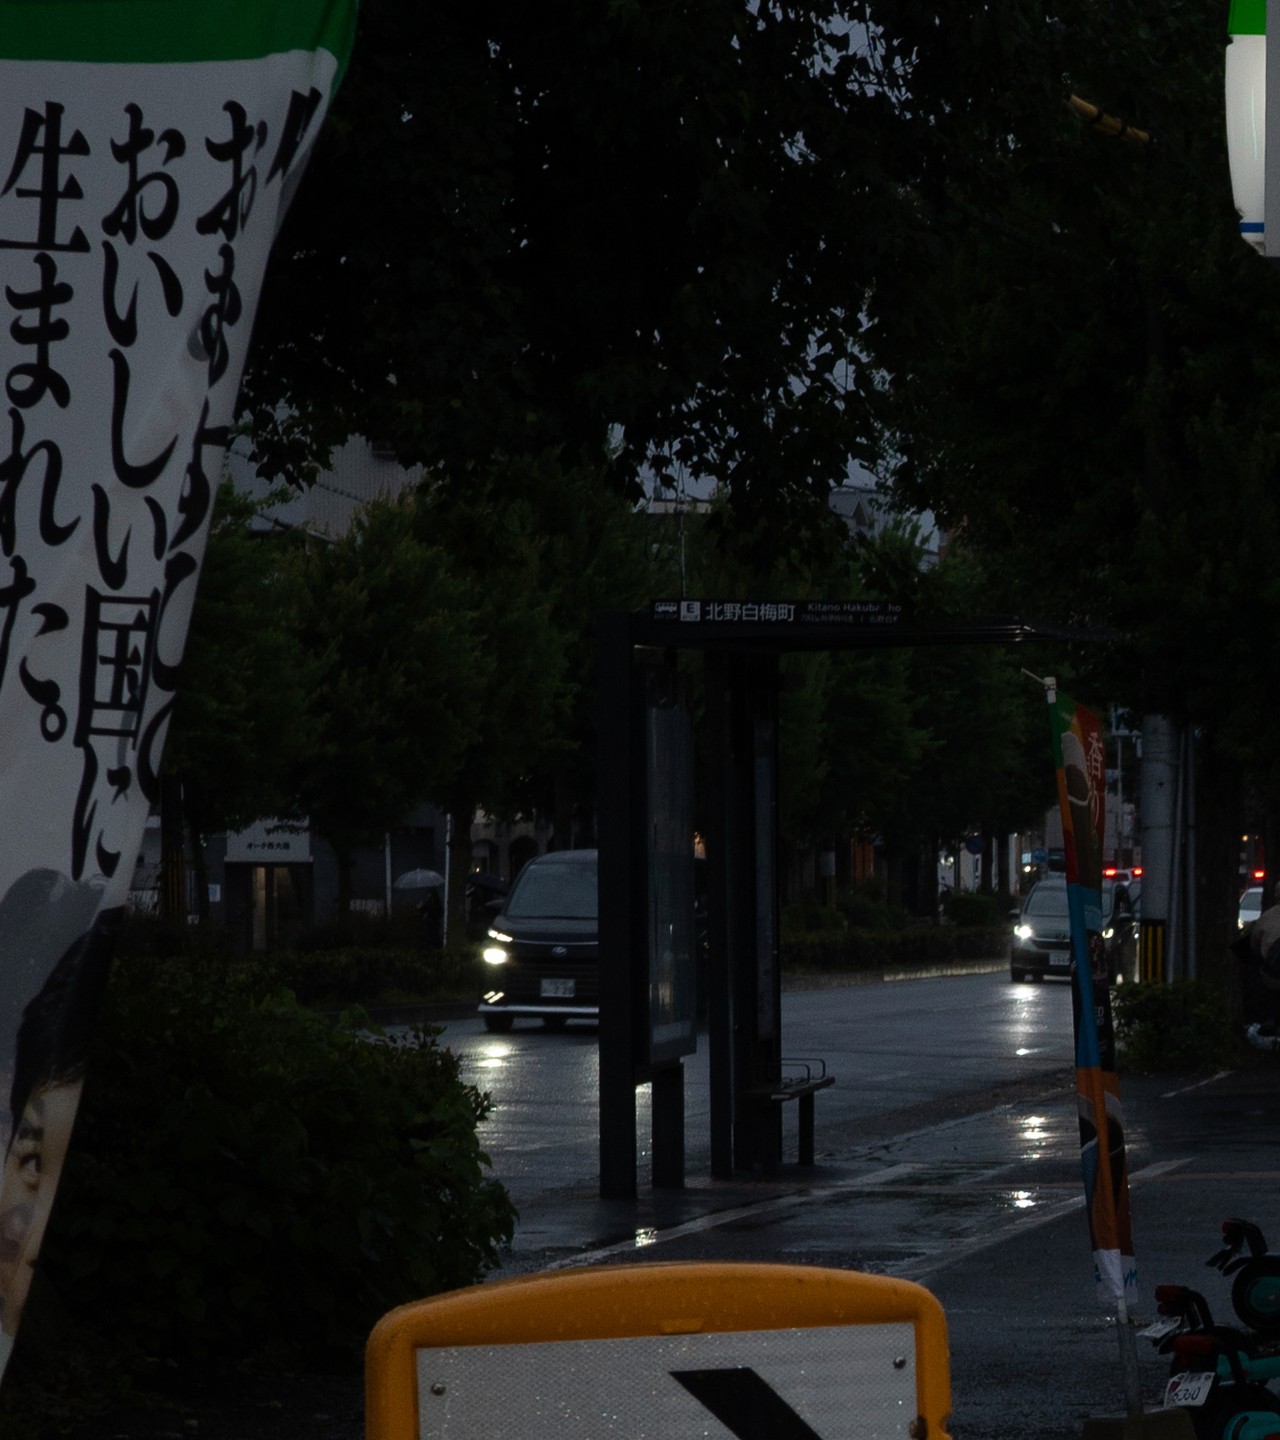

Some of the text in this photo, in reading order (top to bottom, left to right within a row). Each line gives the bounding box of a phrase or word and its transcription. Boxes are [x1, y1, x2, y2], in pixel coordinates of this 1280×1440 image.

[0, 101, 91, 742] 生まれた。
[72, 103, 186, 881] おいしい国に
[705, 602, 796, 621] 北野白梅町
[807, 603, 840, 612] Kitano
